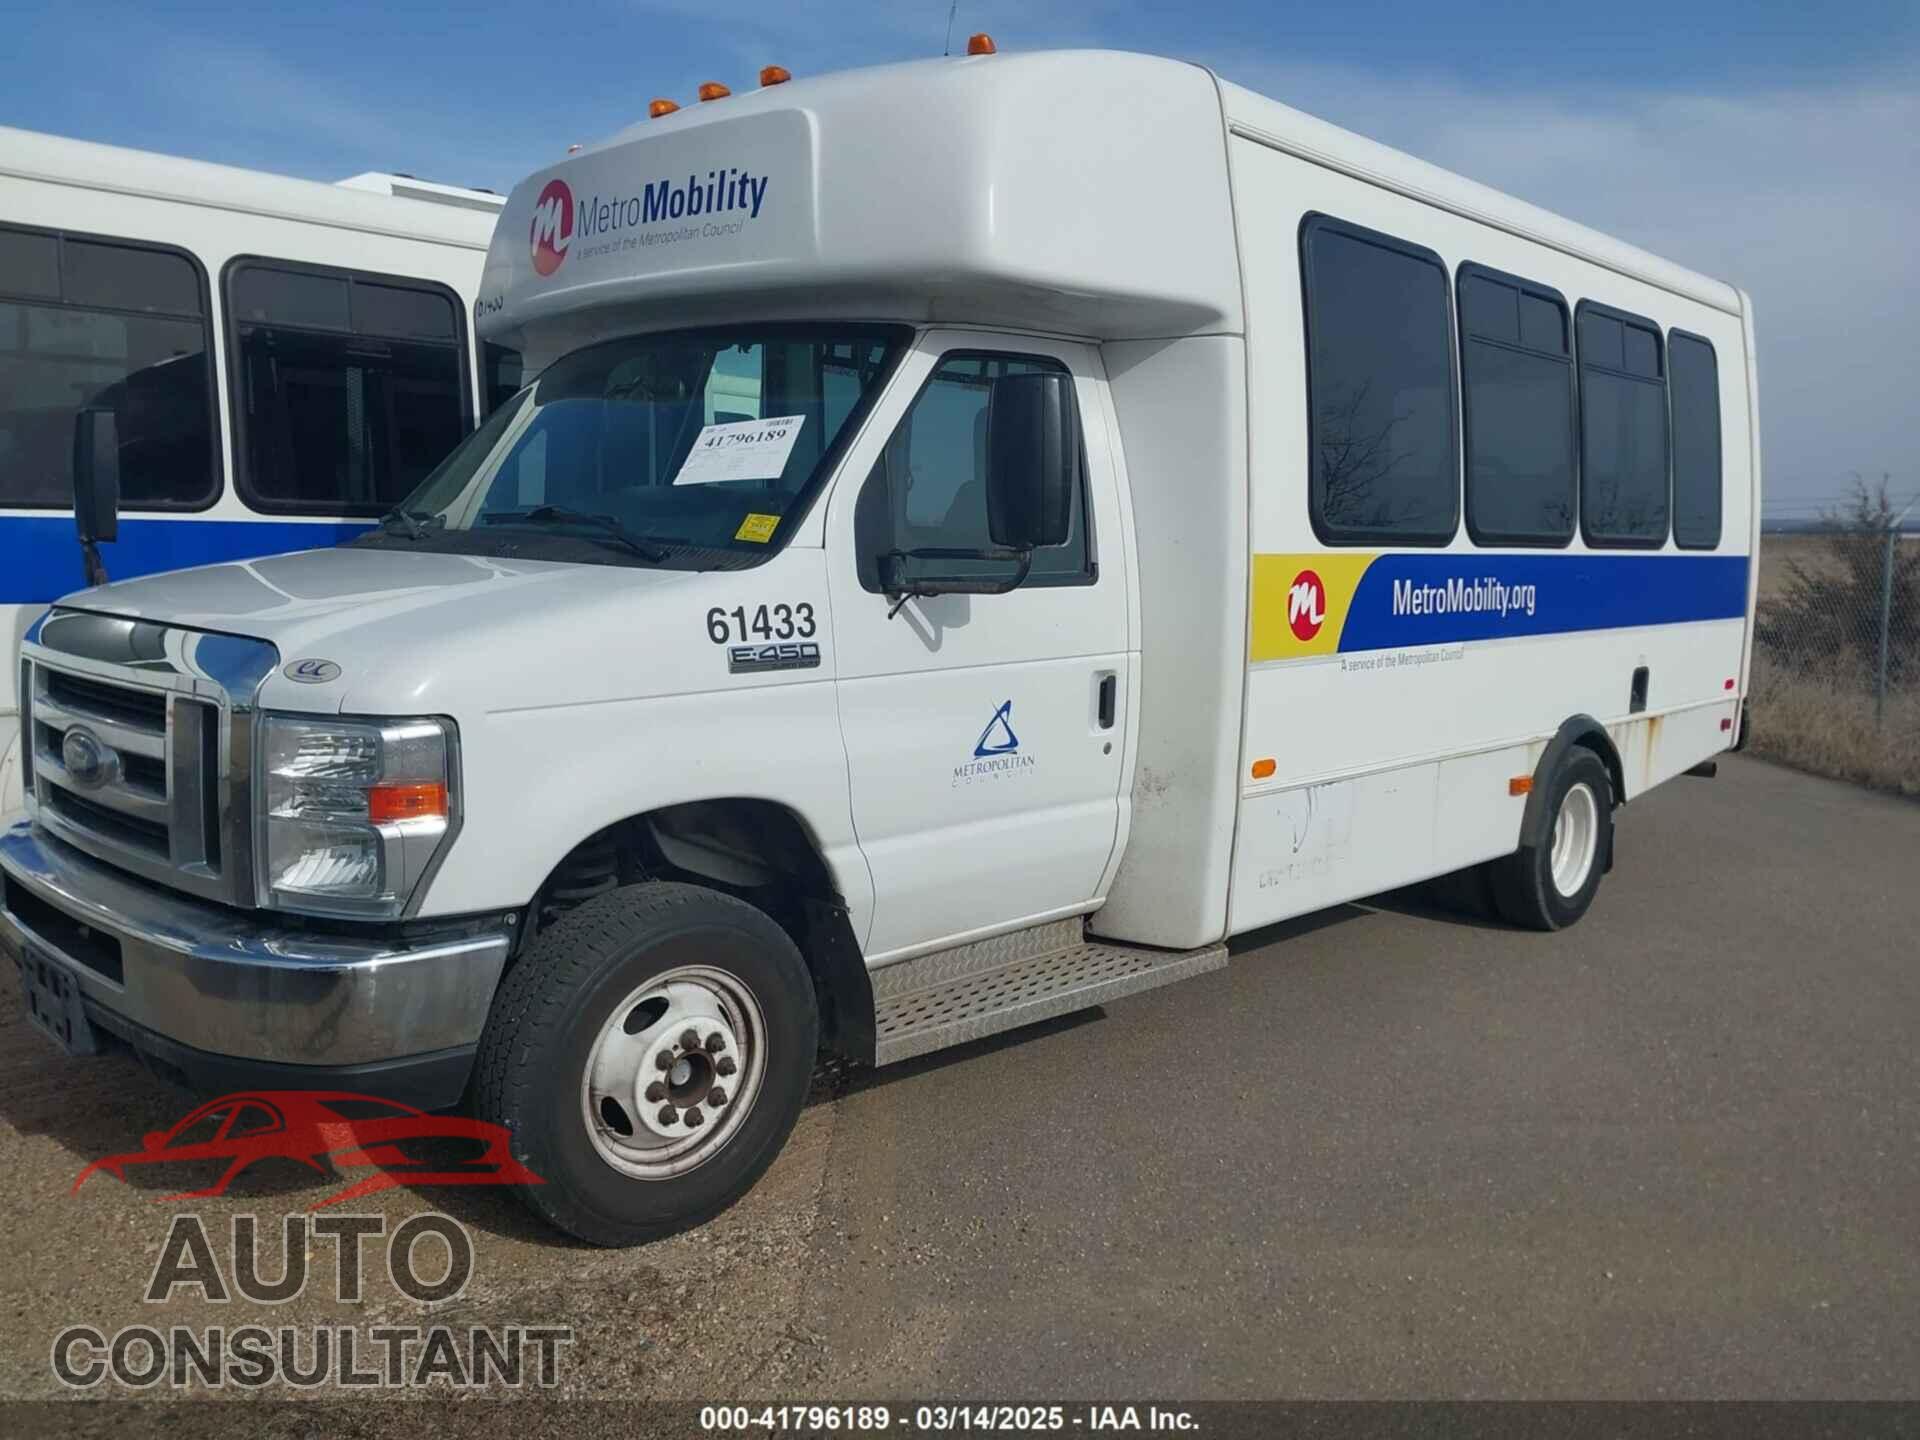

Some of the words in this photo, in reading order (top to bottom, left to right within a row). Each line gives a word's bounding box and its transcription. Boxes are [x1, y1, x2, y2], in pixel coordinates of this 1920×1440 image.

[577, 168, 768, 239] MetroMobility
[639, 226, 700, 248] Metropolitan
[702, 219, 744, 238] Council
[704, 429, 787, 448] 41796189
[1392, 577, 1536, 617] MetroMobility.org
[706, 602, 816, 644] 61433
[731, 642, 820, 663] E-450
[1398, 649, 1440, 669] Metropolitan
[953, 755, 1035, 777] METROPOLITAN
